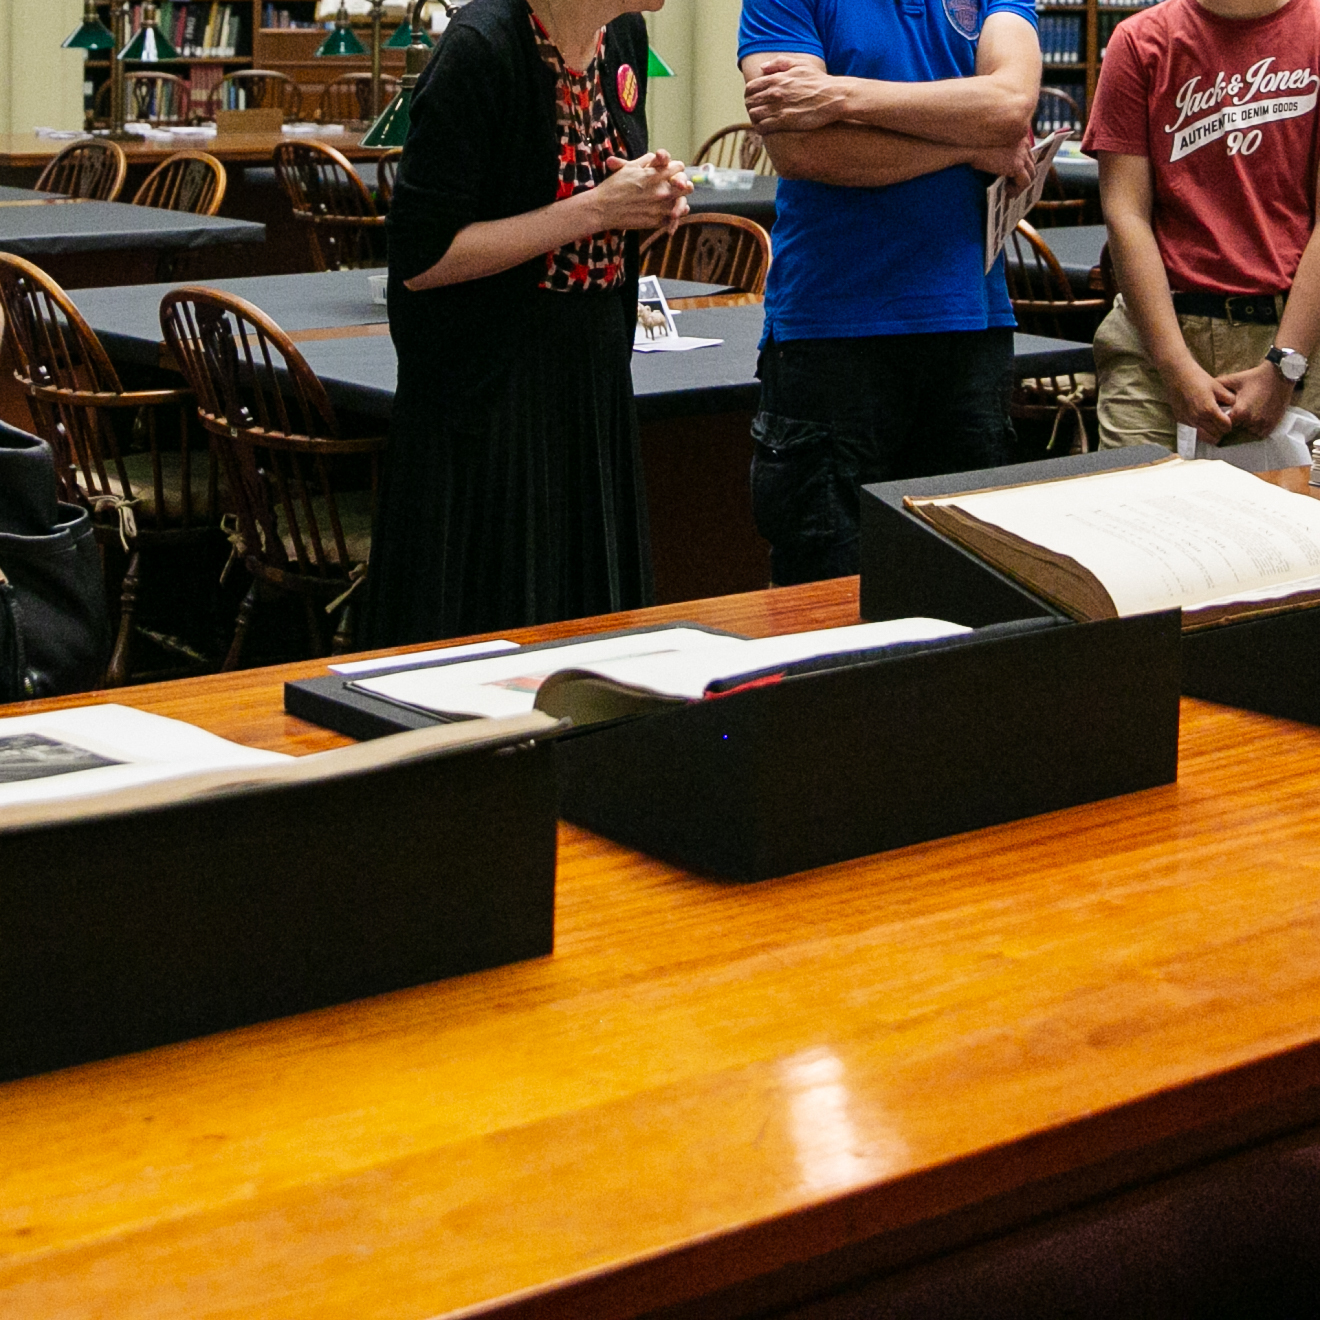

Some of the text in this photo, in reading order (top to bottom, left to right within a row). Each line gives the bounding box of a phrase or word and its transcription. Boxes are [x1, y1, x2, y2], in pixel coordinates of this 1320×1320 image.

[1179, 101, 1299, 151] AUTHENTIC DENIM GOODS
[1226, 129, 1263, 156] 90
